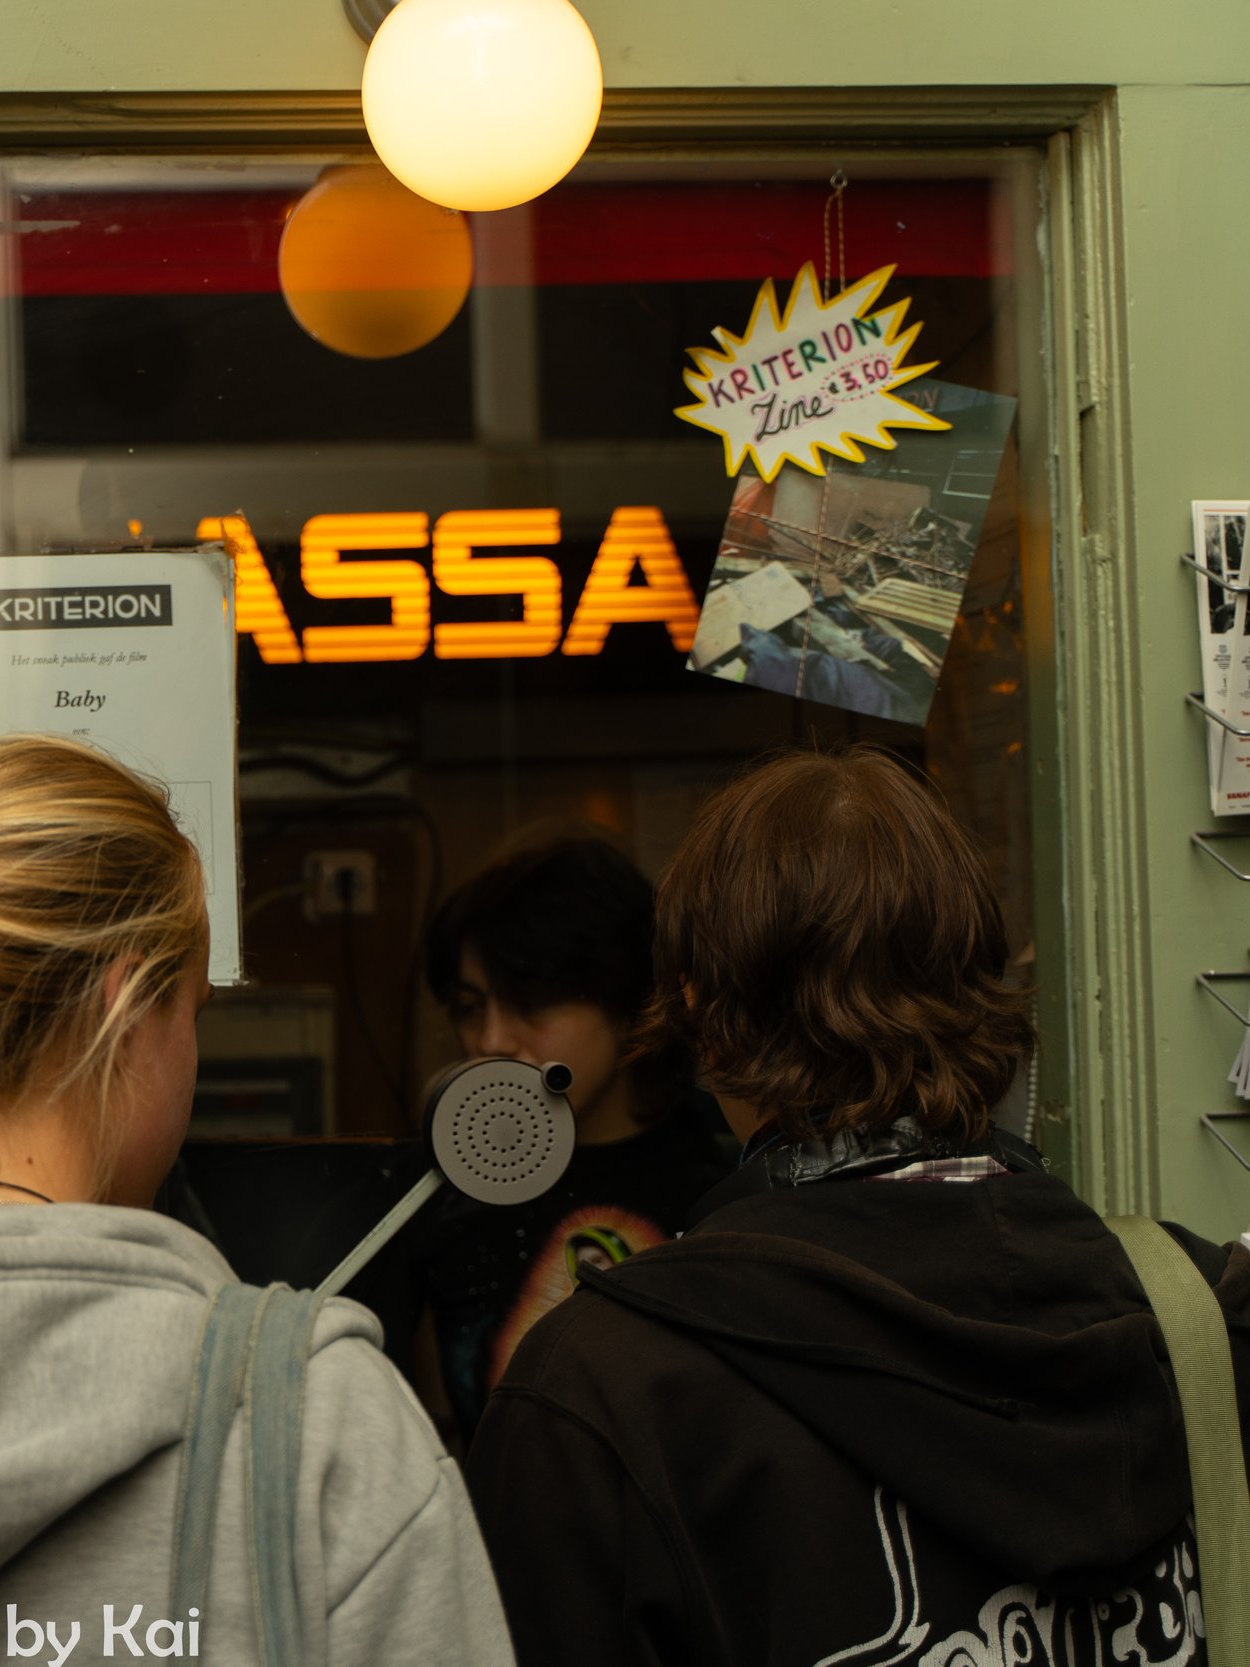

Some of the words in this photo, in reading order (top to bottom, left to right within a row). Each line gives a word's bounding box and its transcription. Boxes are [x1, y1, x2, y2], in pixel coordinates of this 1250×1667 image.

[707, 316, 882, 408] KRITERION
[750, 393, 834, 442] Zine
[196, 506, 700, 664] ASSA
[116, 651, 126, 664] de
[125, 651, 148, 665] film
[54, 689, 106, 713] Baby
